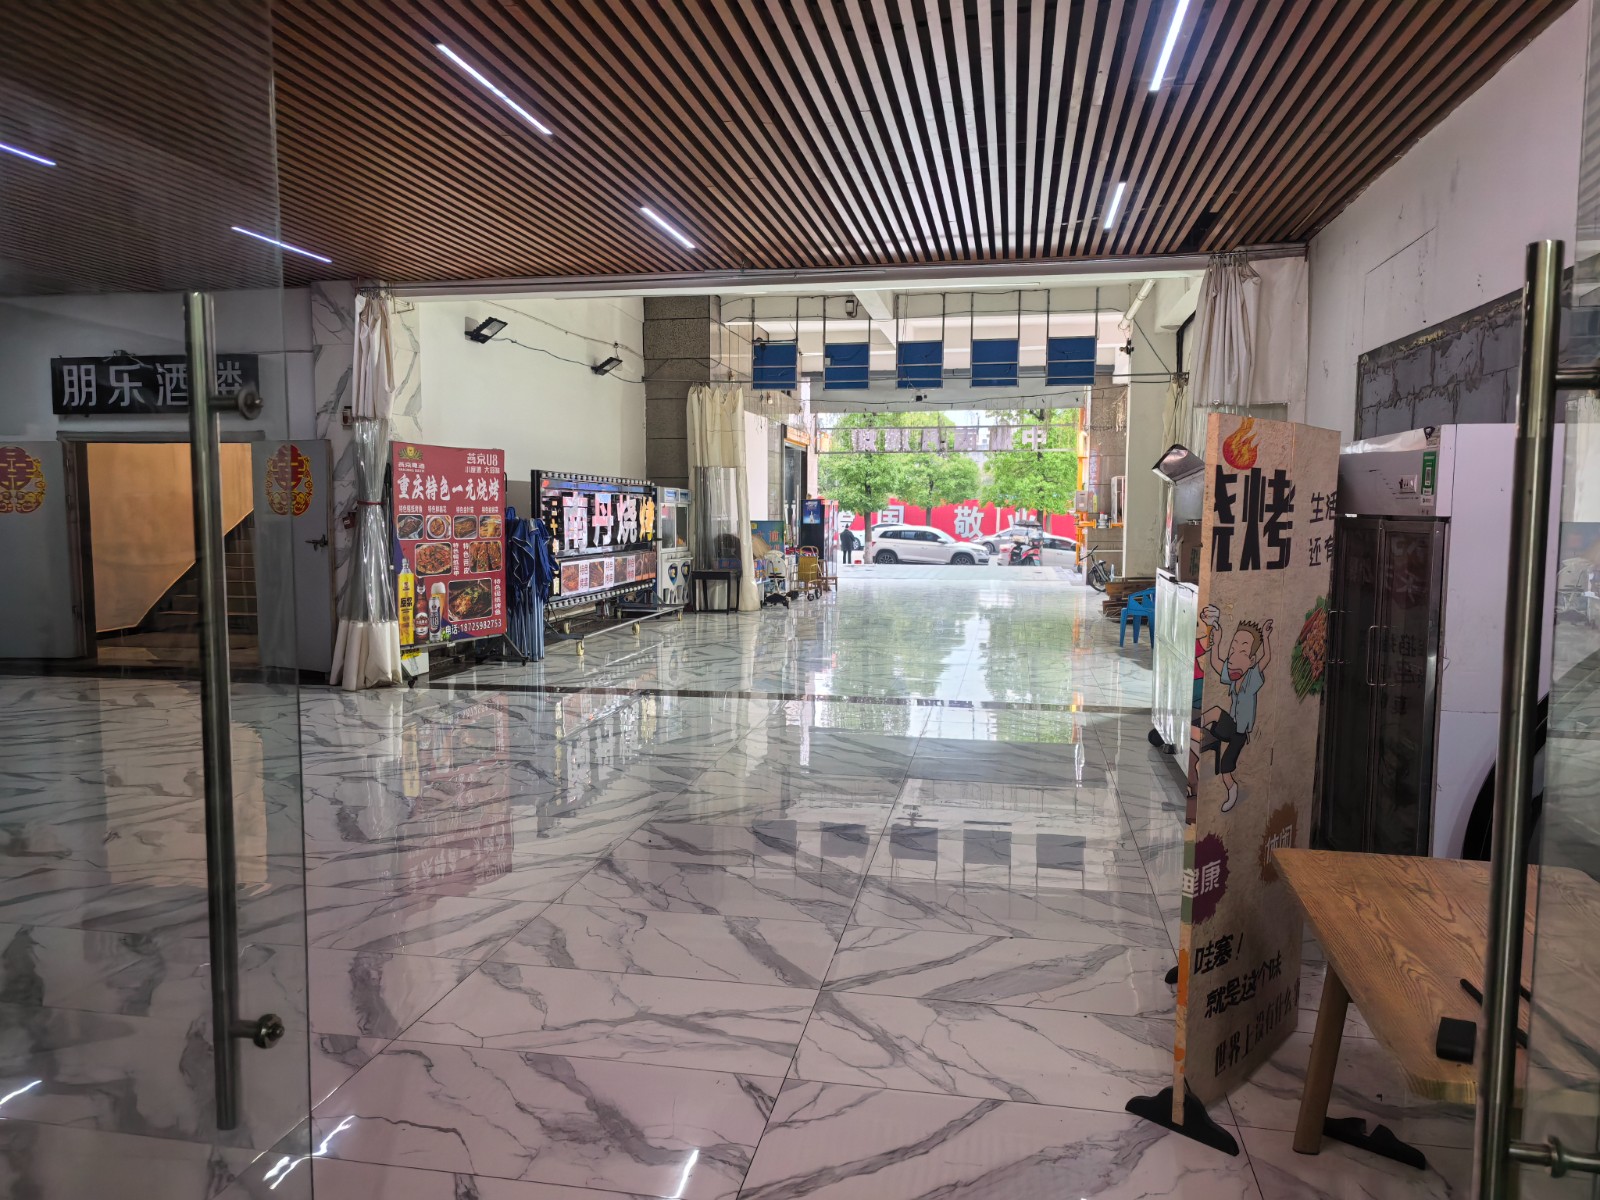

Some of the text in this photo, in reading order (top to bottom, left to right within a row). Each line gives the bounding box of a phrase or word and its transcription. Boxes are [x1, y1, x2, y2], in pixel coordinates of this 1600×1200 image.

[467, 453, 498, 466] 燕京U8
[397, 473, 500, 502] 重庆特色一元烧烤
[1211, 465, 1295, 572] 烧烤
[1204, 950, 1282, 1019] 就是这个味
